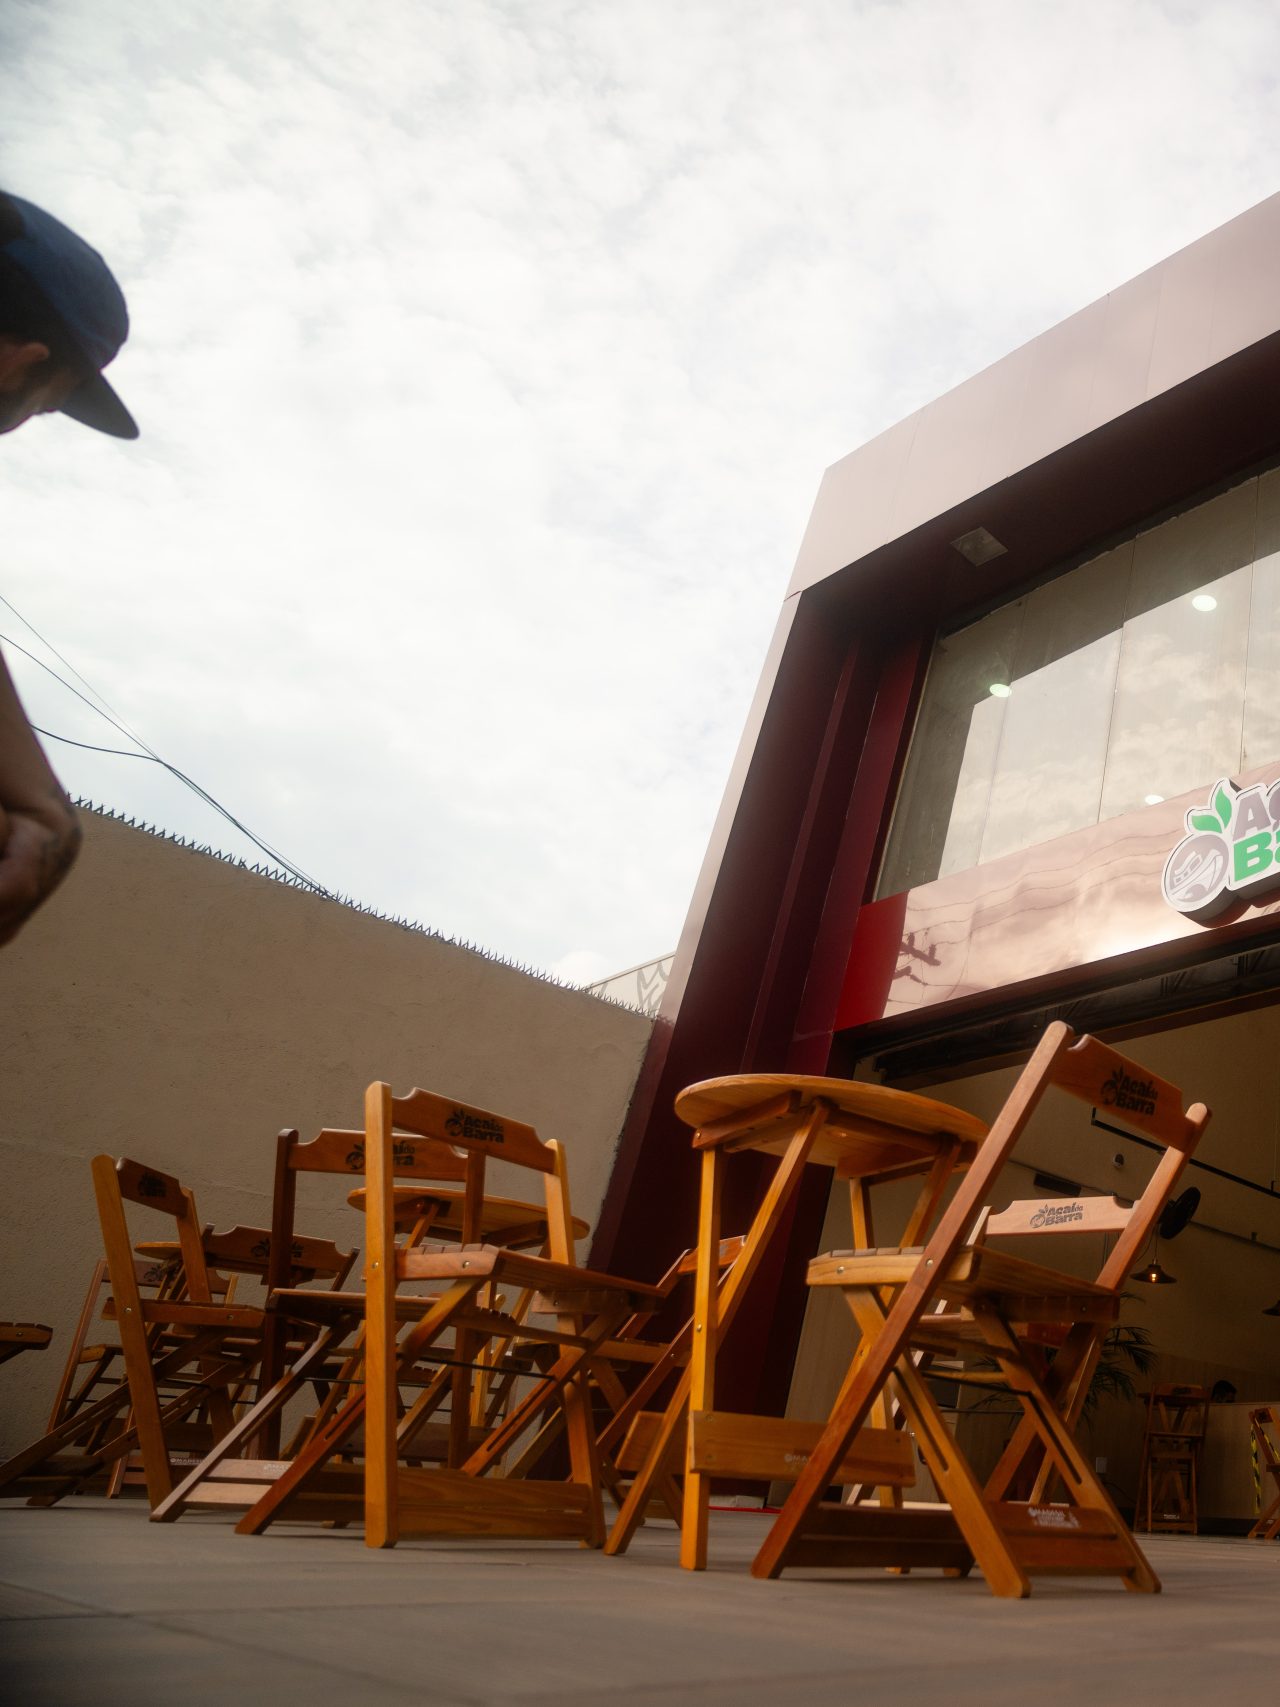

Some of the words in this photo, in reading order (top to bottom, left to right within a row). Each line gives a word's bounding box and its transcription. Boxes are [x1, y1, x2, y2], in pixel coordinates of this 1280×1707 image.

[1115, 1091, 1155, 1116] Barra
[463, 1126, 505, 1144] Barra
[1045, 1211, 1083, 1226] Barra
